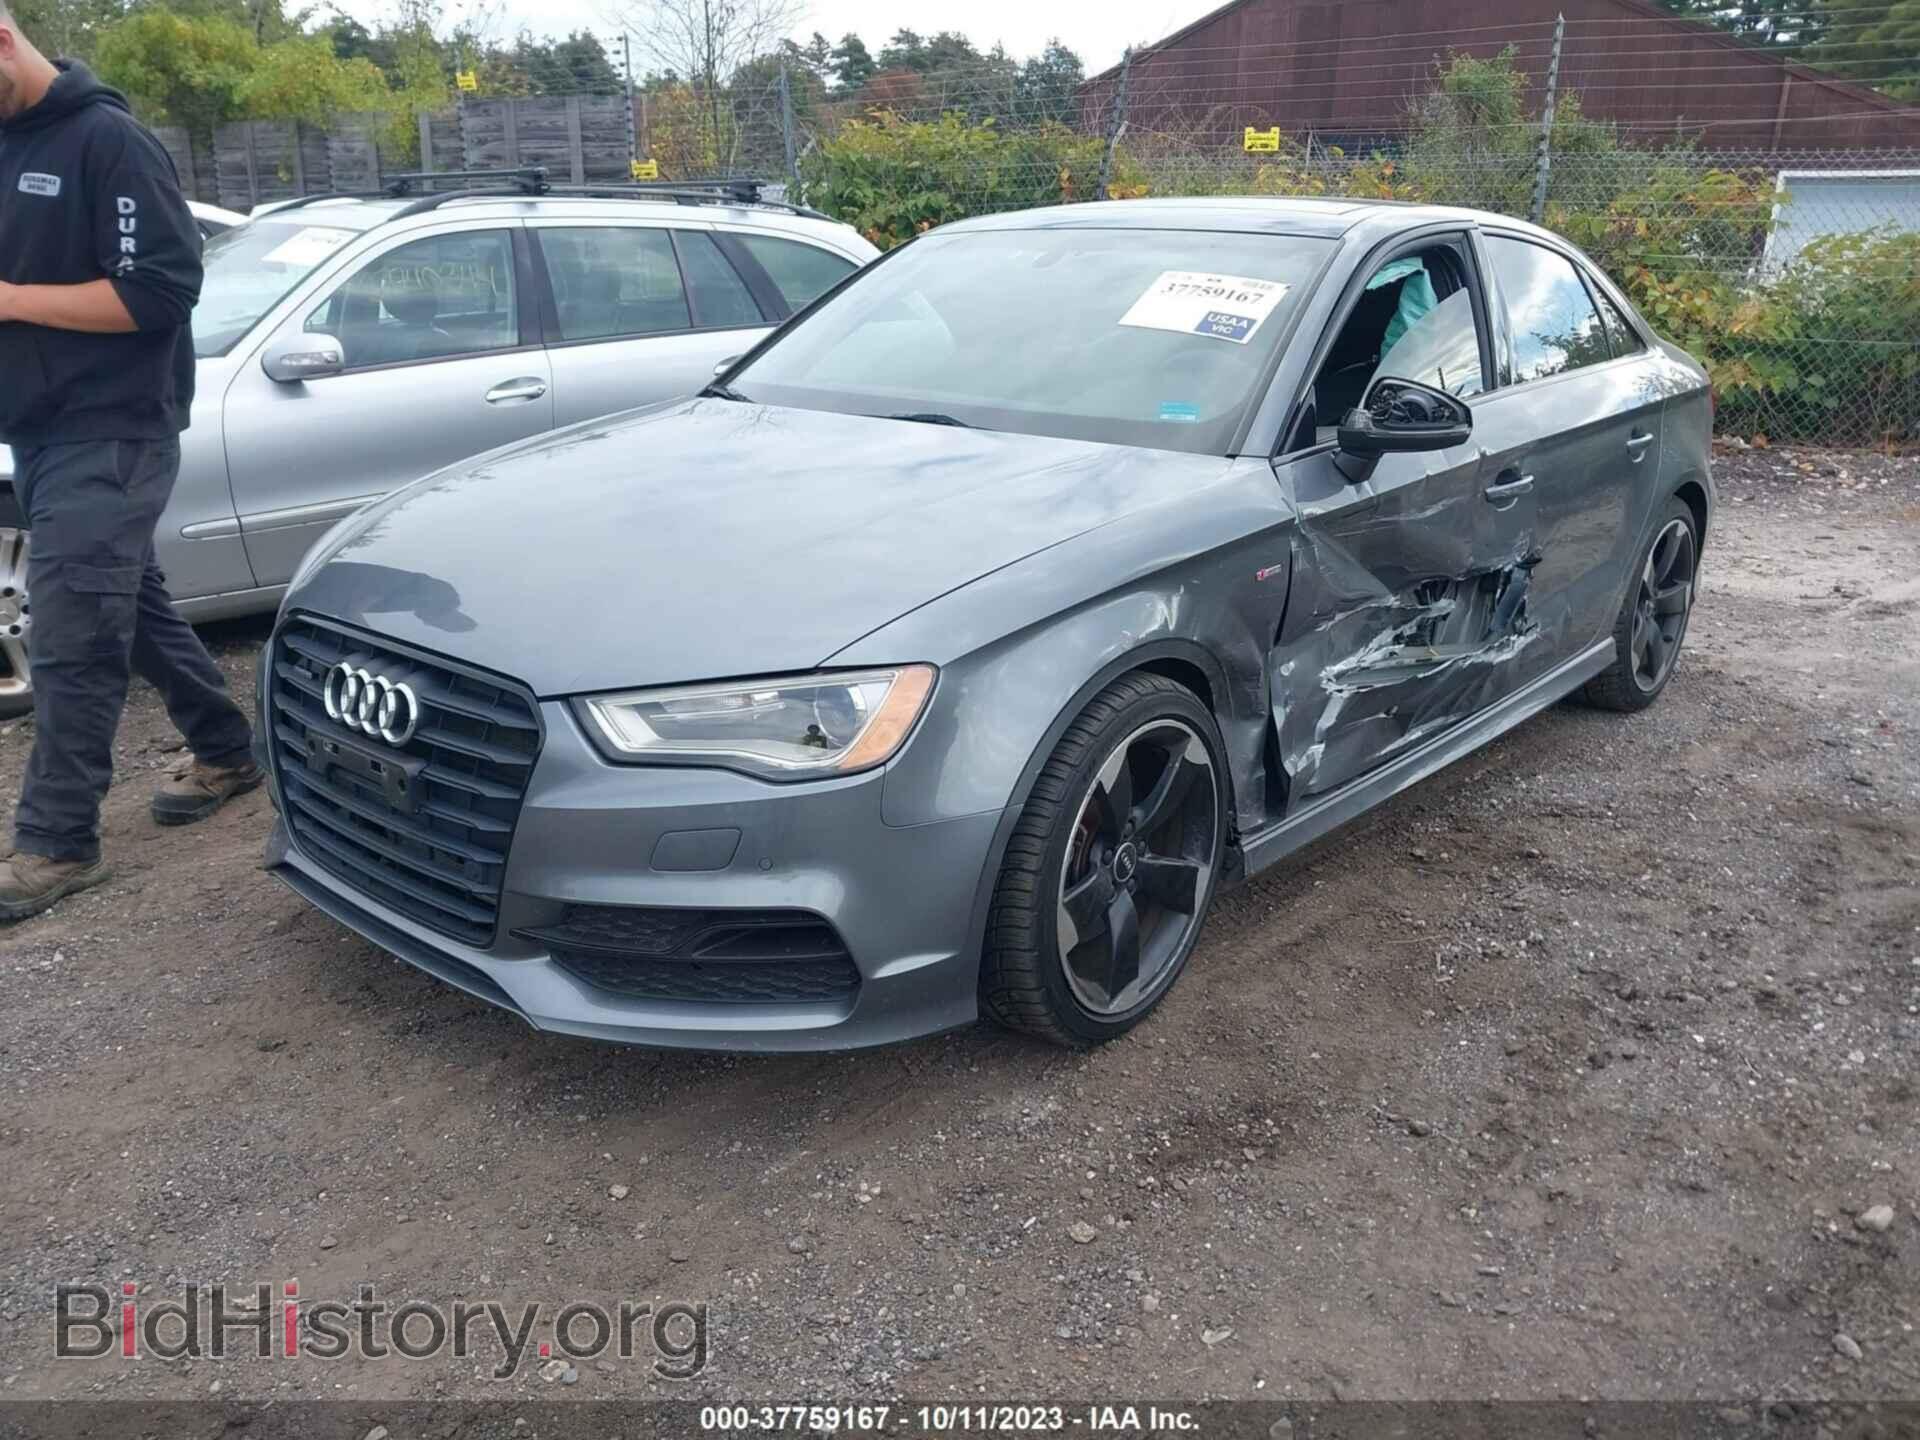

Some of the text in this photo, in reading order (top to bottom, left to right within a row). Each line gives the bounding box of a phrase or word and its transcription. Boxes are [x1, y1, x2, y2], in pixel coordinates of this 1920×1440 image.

[1161, 283, 1264, 304] 37759167
[1207, 313, 1248, 329] USAA
[1211, 325, 1233, 334] VIC
